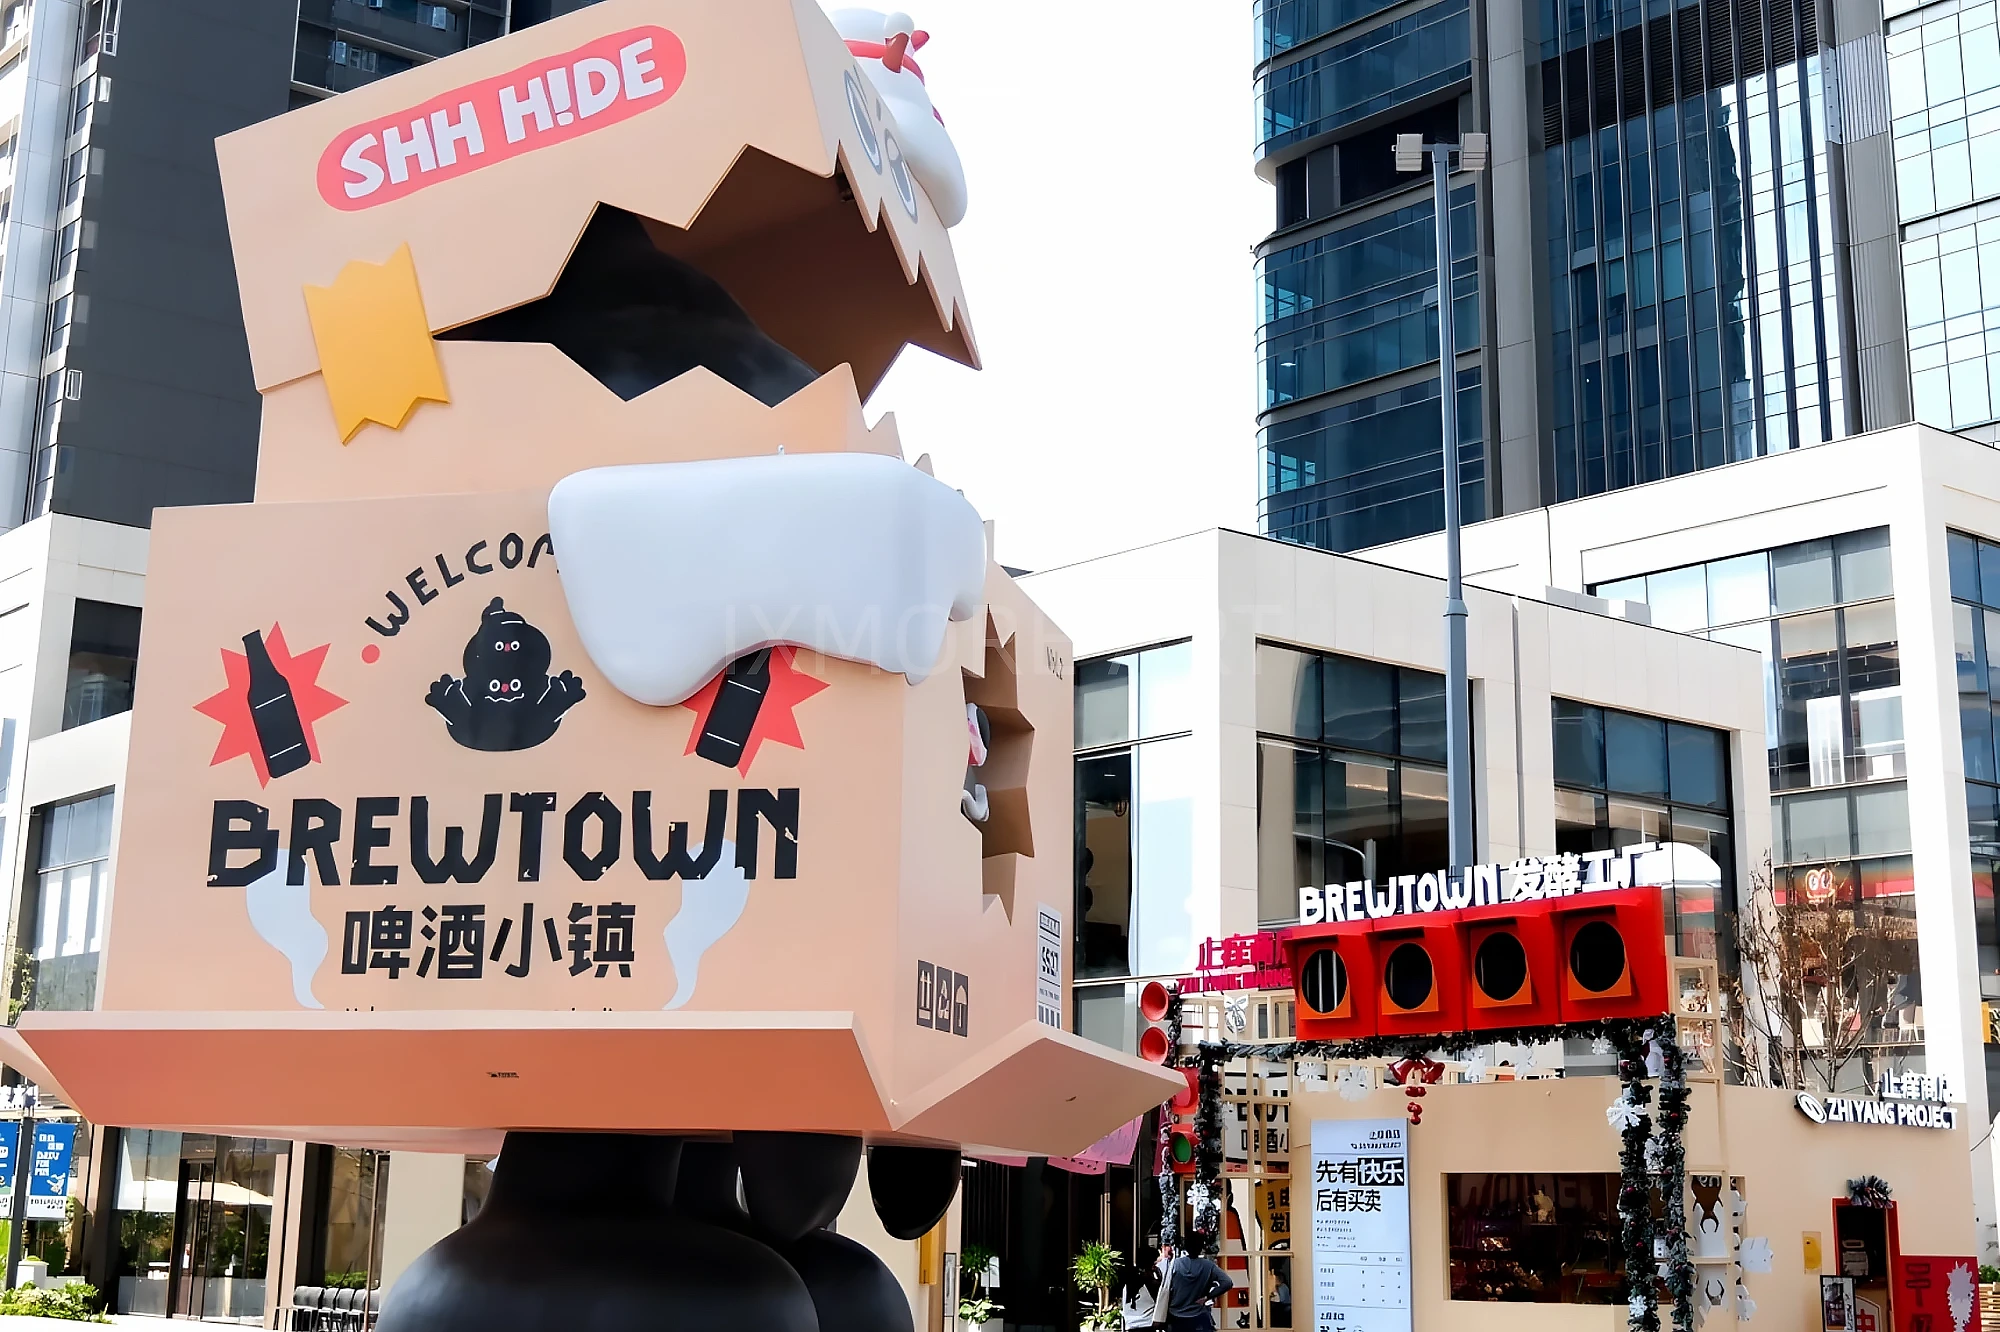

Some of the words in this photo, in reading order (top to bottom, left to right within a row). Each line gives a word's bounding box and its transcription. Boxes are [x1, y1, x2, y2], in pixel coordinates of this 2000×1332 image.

[341, 101, 485, 198] SHH
[499, 38, 664, 144] H!DE
[206, 788, 800, 887] BREWTOWN
[1299, 863, 1499, 925] BREWTOWN
[341, 902, 636, 979] 啤酒小镇
[1898, 1103, 1958, 1130] PROJECT
[1315, 1158, 1404, 1185] 先有快乐
[1316, 1187, 1382, 1212] 后有买卖
